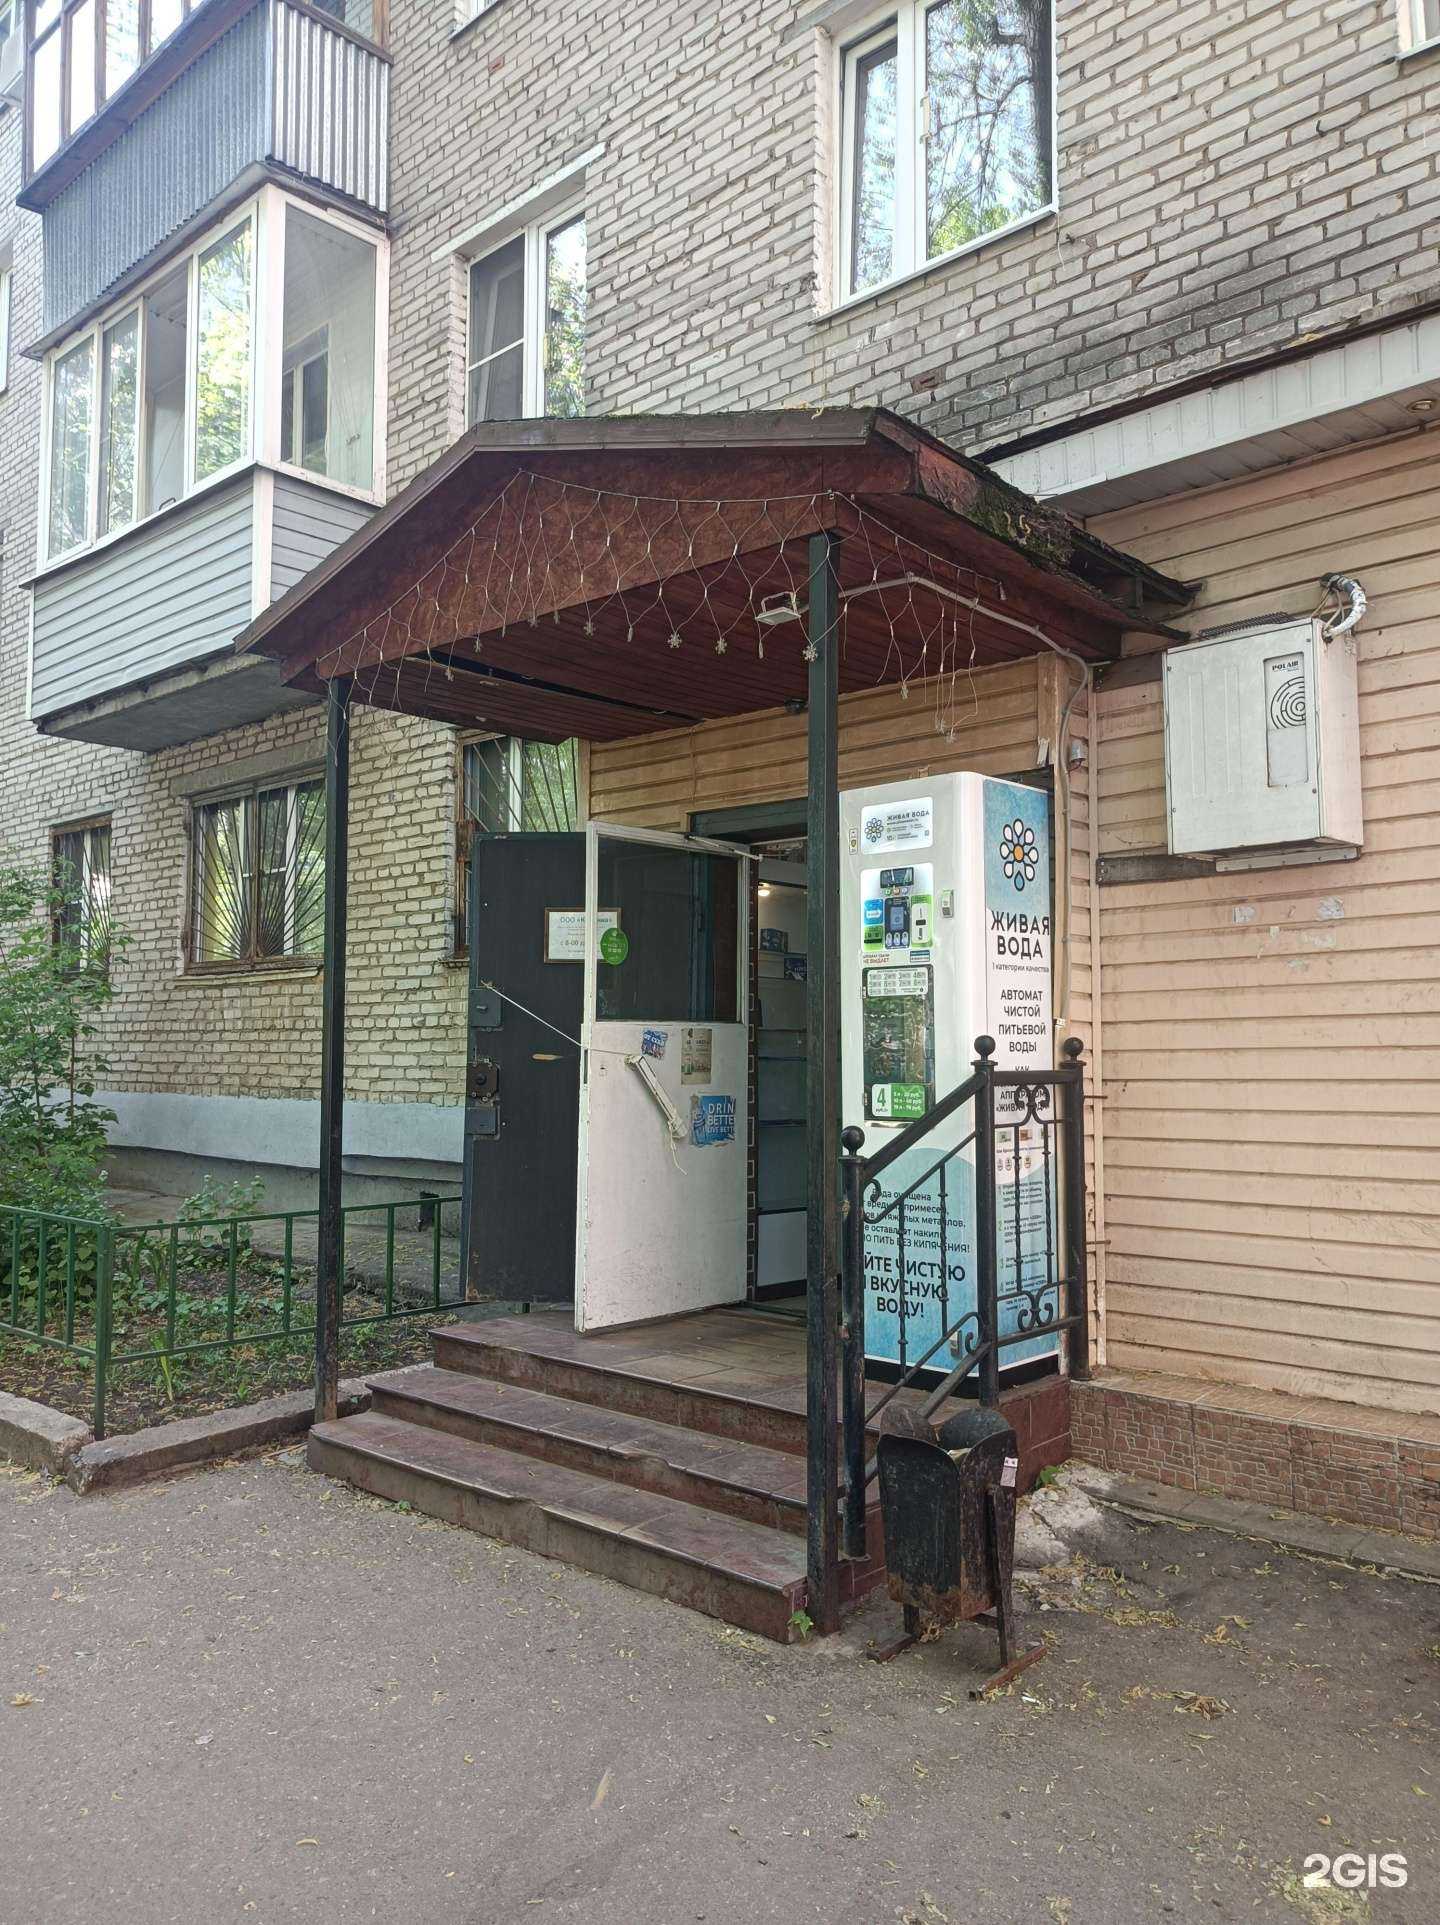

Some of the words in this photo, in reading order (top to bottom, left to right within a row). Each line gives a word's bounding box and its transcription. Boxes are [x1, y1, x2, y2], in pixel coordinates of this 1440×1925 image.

[886, 812, 910, 821] ЖИВАЯ
[911, 809, 930, 818] ВОДА
[990, 910, 1050, 936] ЖИВАЯ
[997, 935, 1043, 960] ВОДА
[996, 964, 1025, 973] категории
[1000, 989, 1043, 1001] АВТОМАТ
[1003, 1004, 1041, 1017] ЧИСТОЙ
[998, 1022, 1047, 1036] ПИТЬЕВОЙ
[1009, 1041, 1037, 1054] ВОДЫ
[877, 1087, 886, 1107] 4
[893, 1192, 932, 1201] очщена
[867, 1200, 903, 1210] вред
[904, 1204, 949, 1215] примесе,
[885, 1213, 920, 1223] тяжлых
[921, 1218, 966, 1228] металов,
[873, 1235, 895, 1246] ПИТЬ
